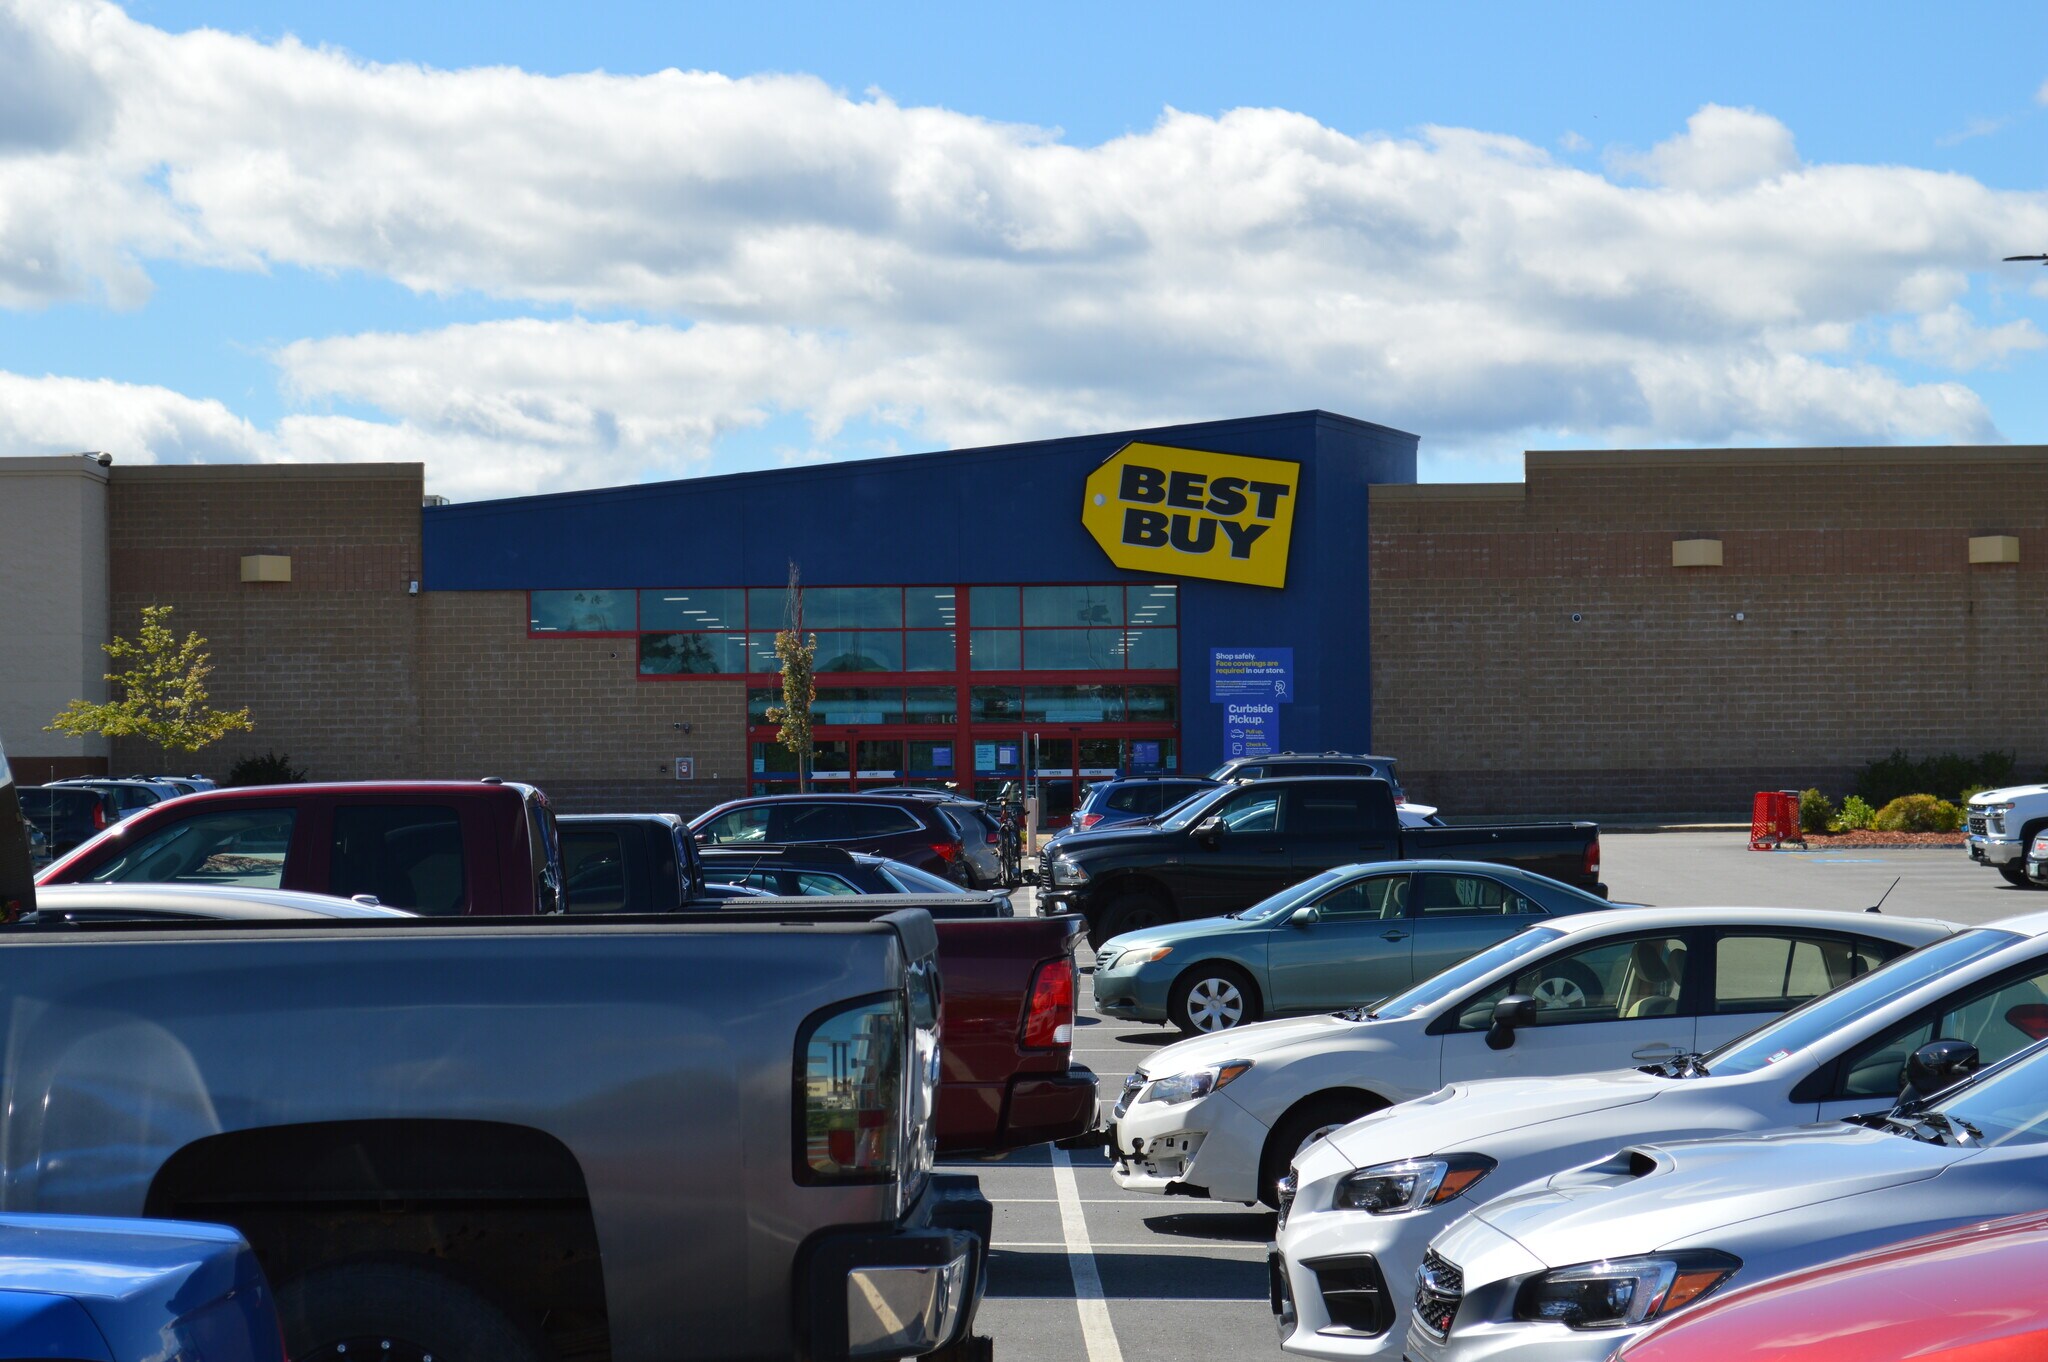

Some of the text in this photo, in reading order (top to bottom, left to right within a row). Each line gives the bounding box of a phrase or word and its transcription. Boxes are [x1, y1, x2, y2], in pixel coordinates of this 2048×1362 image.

[1118, 463, 1290, 520] BEST
[1121, 507, 1271, 560] BUY
[1228, 704, 1274, 713] Curbside
[1228, 714, 1264, 726] Pickup.
